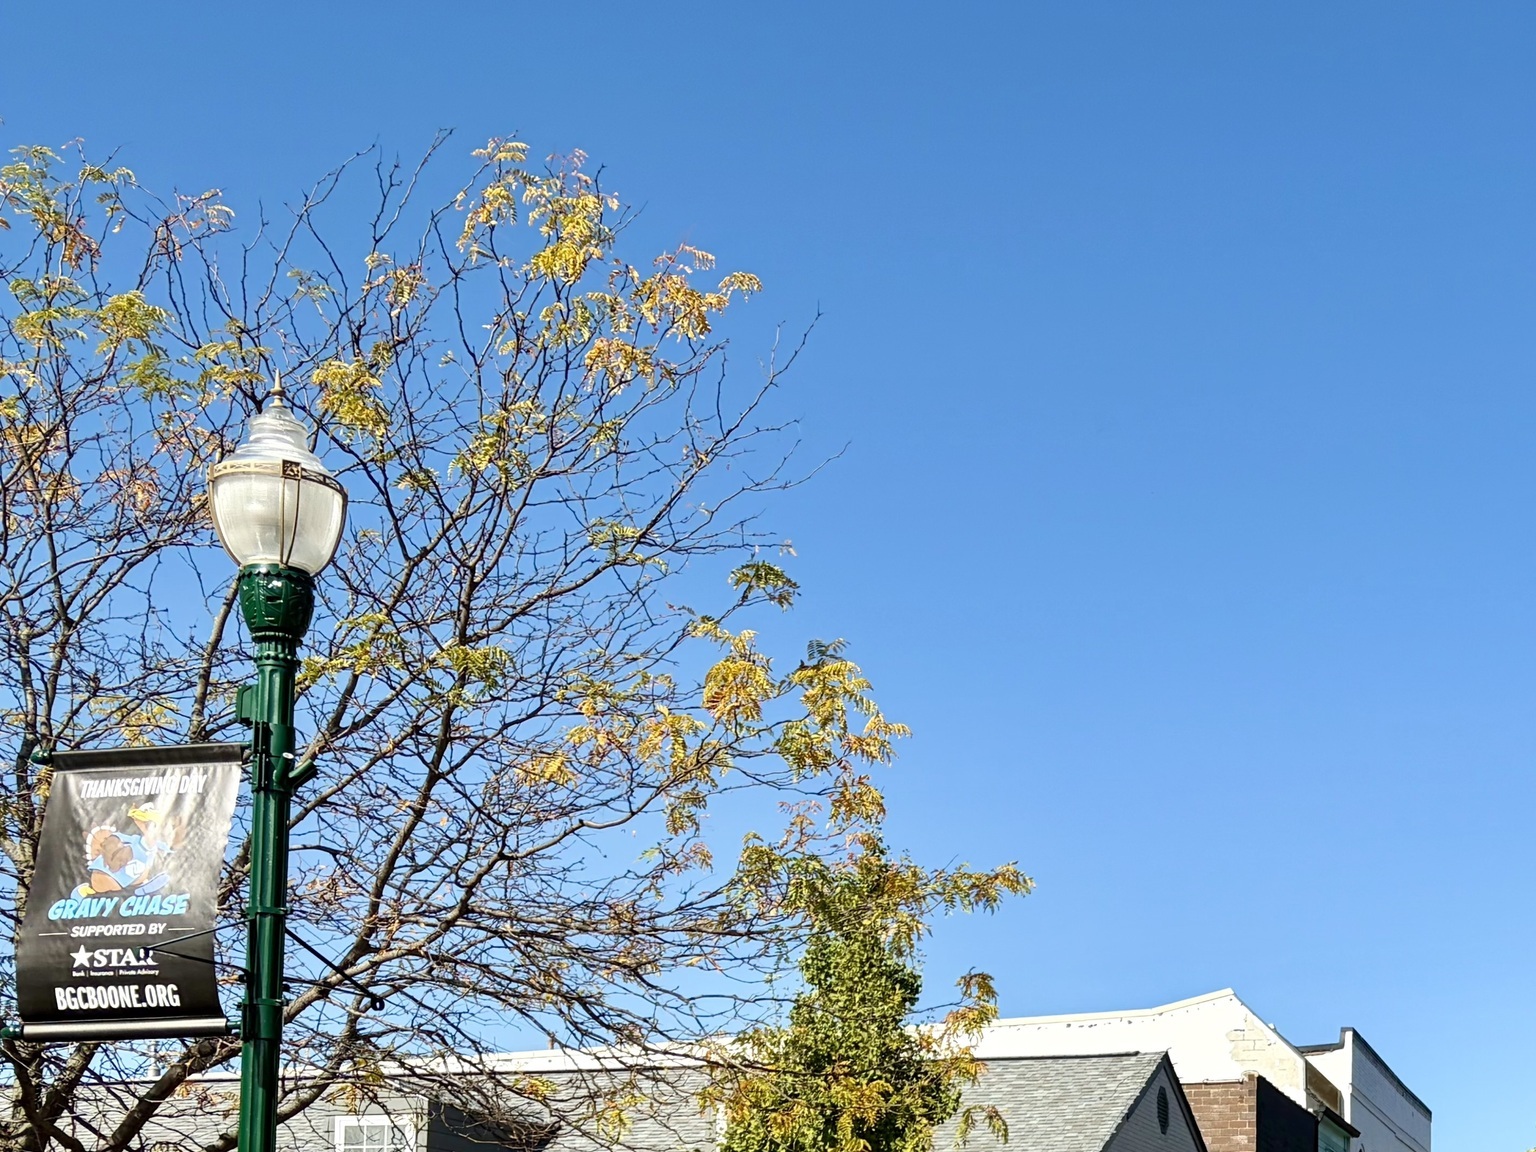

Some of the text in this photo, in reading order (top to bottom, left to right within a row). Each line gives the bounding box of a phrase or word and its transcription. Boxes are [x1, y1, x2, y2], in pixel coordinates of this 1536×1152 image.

[80, 774, 207, 799] THANKSGIVING DAY
[48, 893, 190, 921] GRAVY CHASE
[70, 923, 167, 938] SUPPORTED BY
[54, 984, 181, 1011] BGCBOONE.ORG
